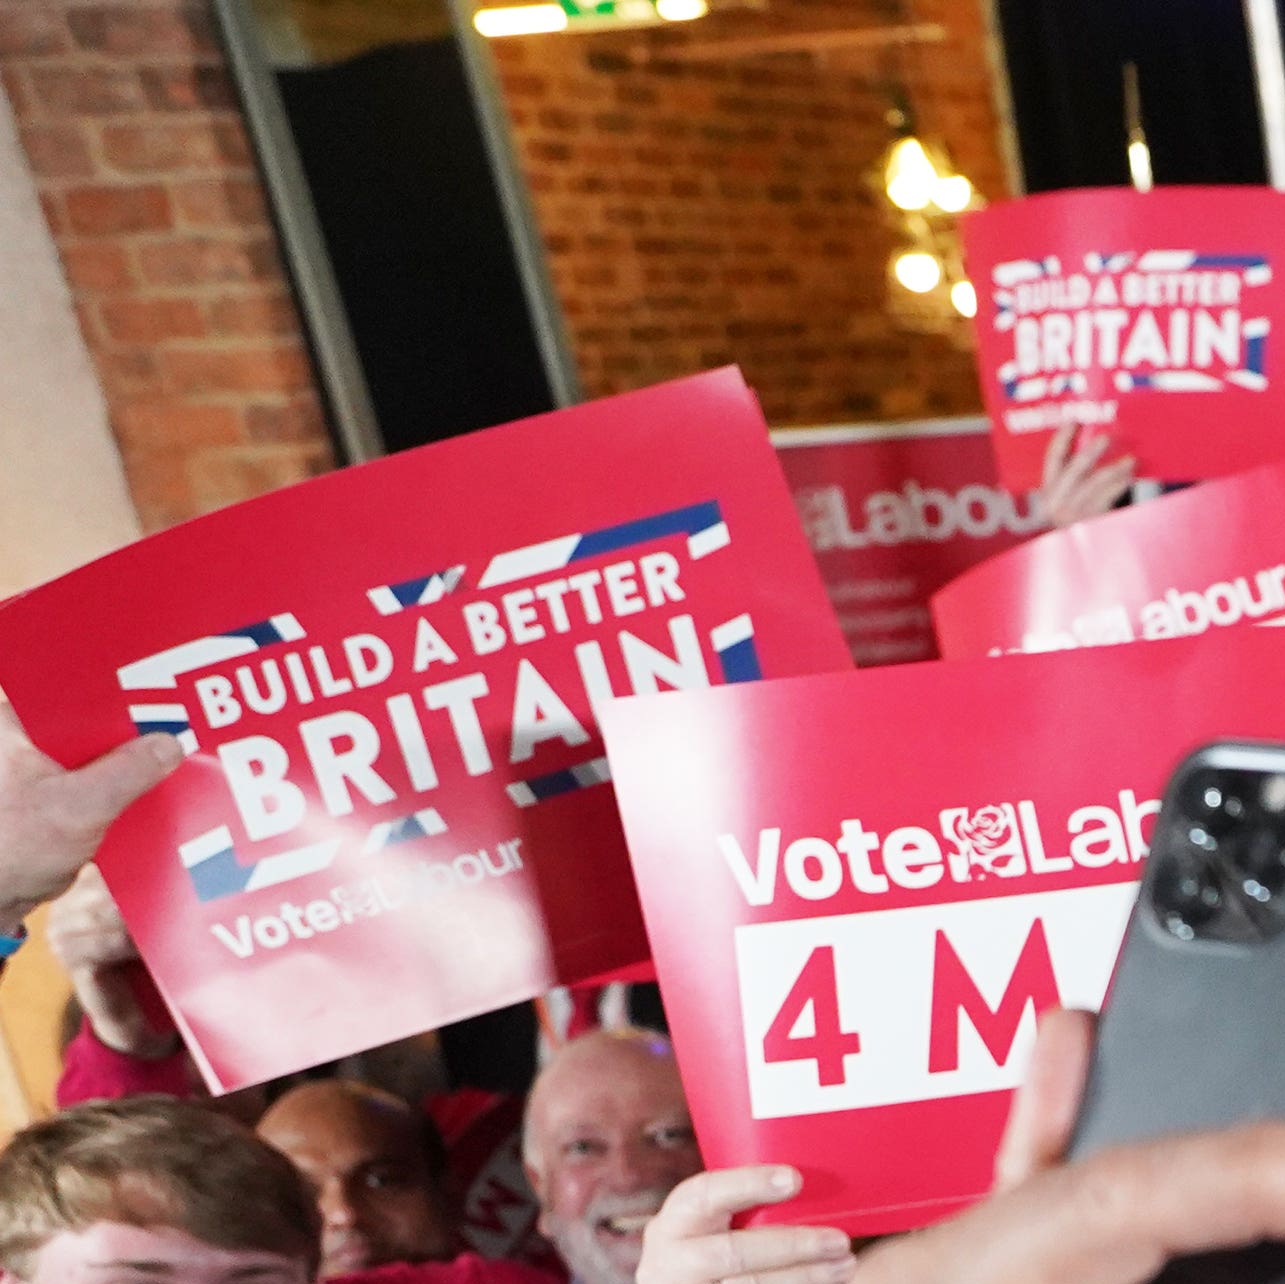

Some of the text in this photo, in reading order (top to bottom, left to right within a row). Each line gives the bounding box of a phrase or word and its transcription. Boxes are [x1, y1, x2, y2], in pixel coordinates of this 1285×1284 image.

[1014, 270, 1241, 316] BUILD A BETTER
[1013, 306, 1241, 376] BRITAIN
[840, 480, 1050, 551] Labou
[193, 550, 686, 729] BUILD A BETTER
[217, 613, 712, 843] BRITAIN
[718, 788, 1163, 907] Vote Lab
[211, 889, 338, 961] Vote
[762, 945, 860, 1087] 4
